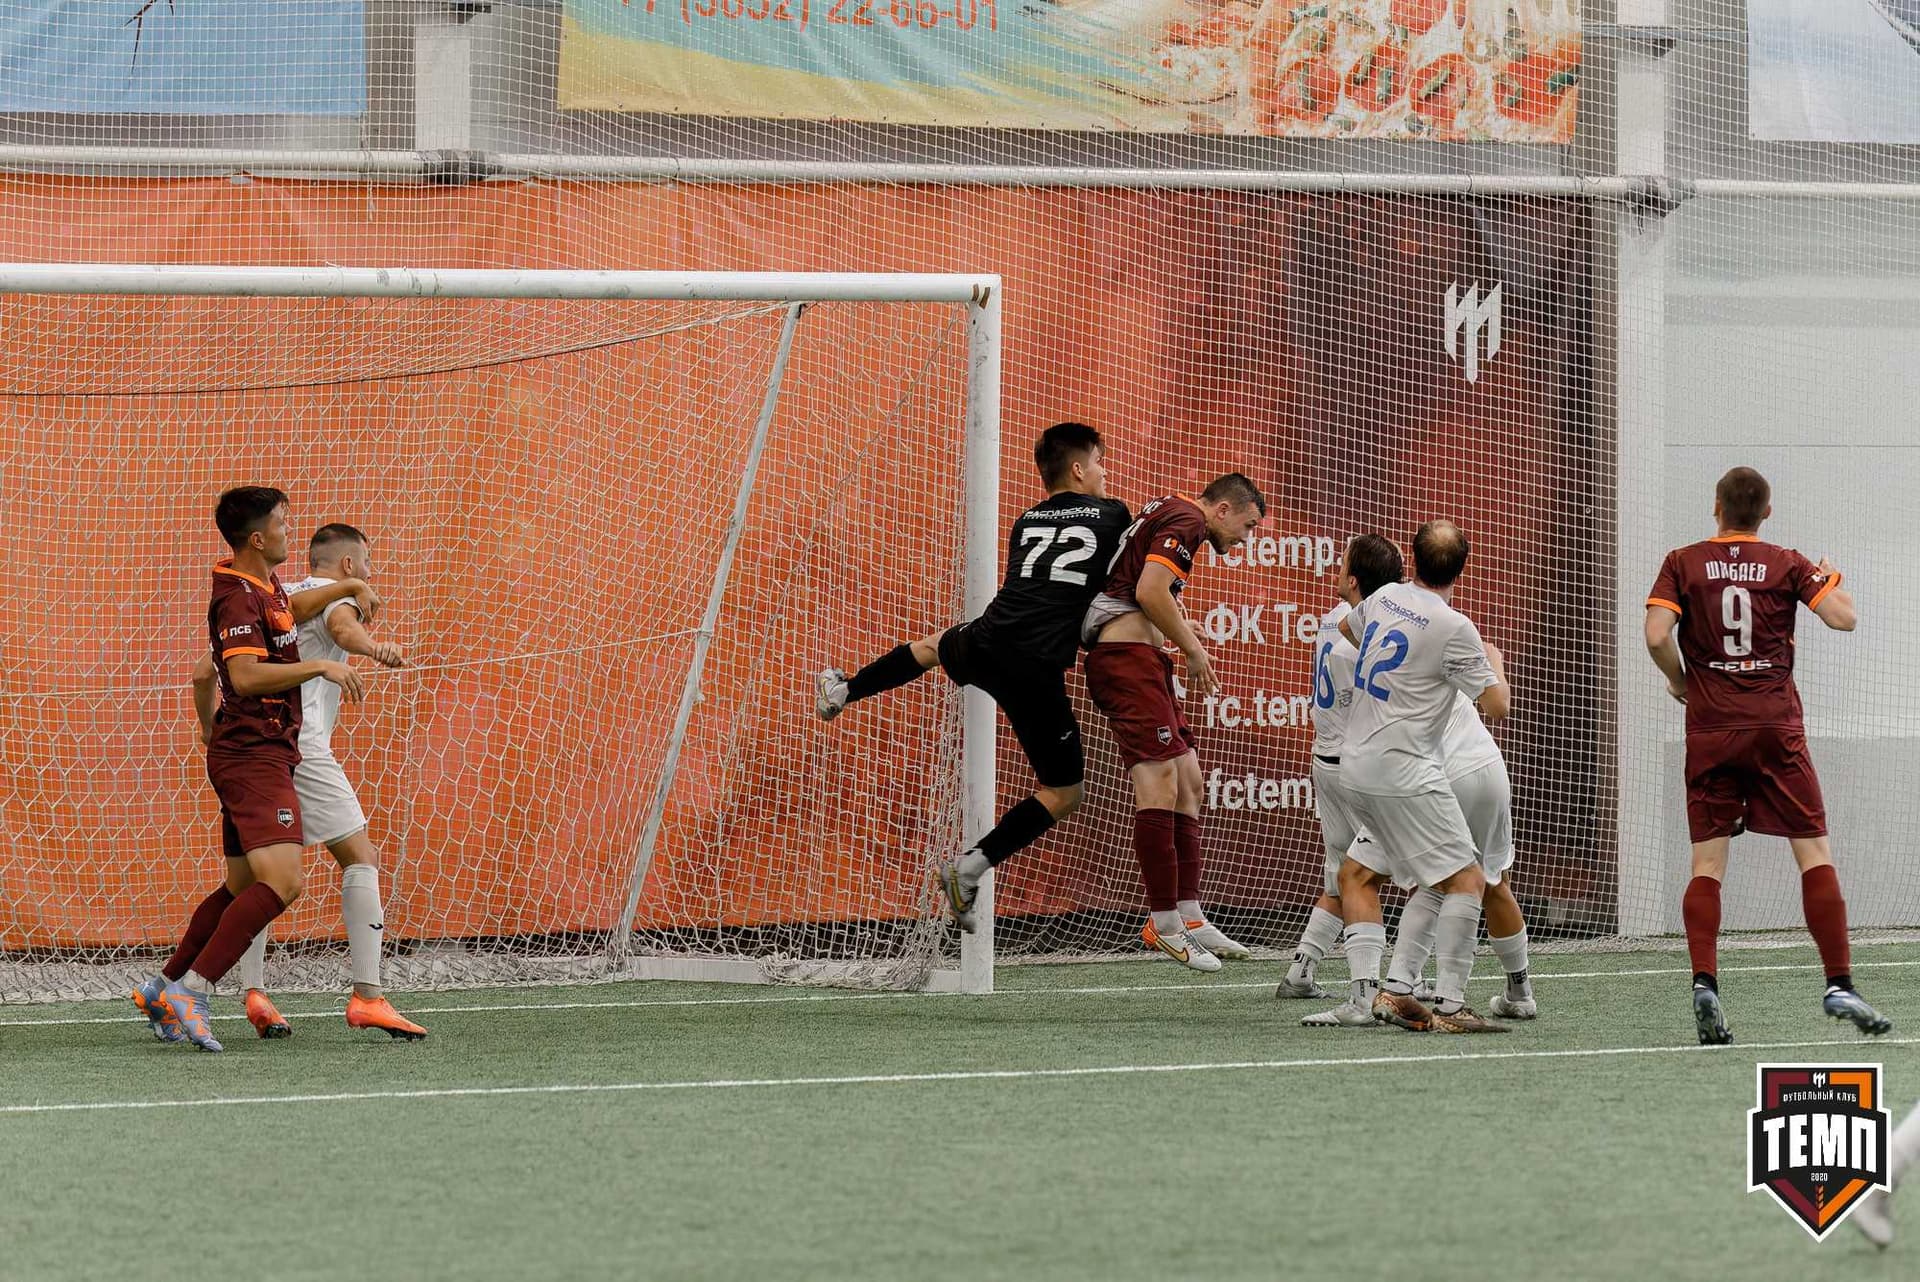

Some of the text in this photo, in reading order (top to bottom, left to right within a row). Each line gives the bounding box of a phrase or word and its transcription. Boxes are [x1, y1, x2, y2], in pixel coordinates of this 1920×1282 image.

[1020, 525, 1097, 586] 72
[1207, 530, 1352, 577] fctemp.
[230, 625, 252, 637] ПСБ
[1205, 603, 1319, 645] ФК Те
[1722, 585, 1753, 656] 9
[1355, 620, 1409, 702] 12
[1203, 687, 1313, 727] fc.tem
[1207, 768, 1318, 817] fctem
